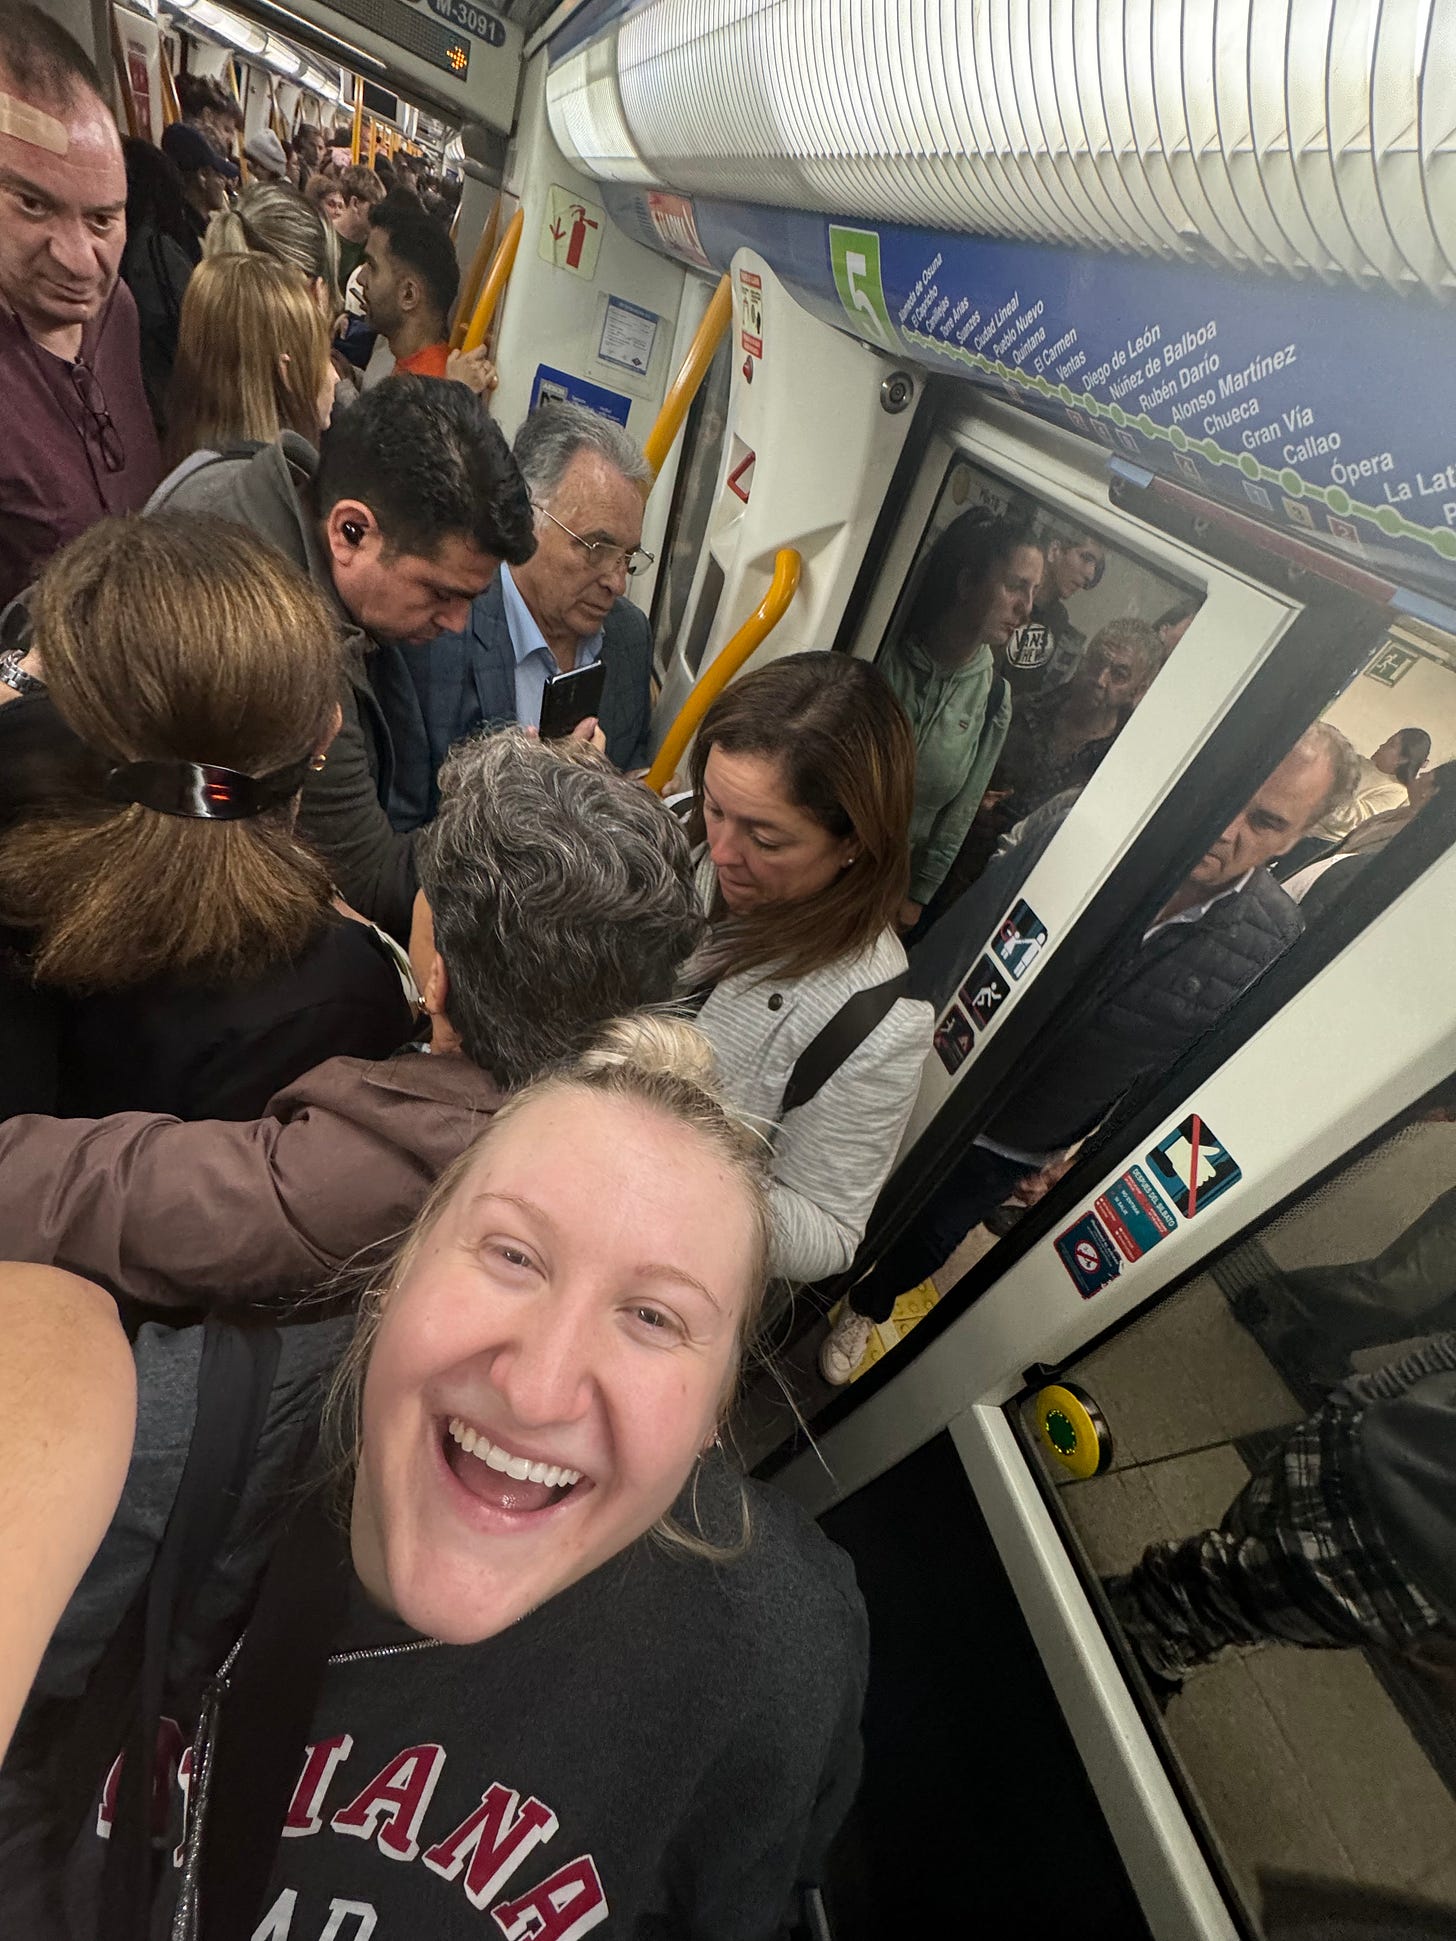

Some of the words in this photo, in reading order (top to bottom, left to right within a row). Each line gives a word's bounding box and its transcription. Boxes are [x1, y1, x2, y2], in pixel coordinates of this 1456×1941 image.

[436, 0, 496, 41] M-3091
[922, 252, 943, 285] Osuna
[974, 319, 997, 350] Ciudad
[994, 290, 1019, 328] Lineal
[993, 328, 1017, 357] Pueblo
[1015, 300, 1044, 335] Nuevo
[1012, 326, 1046, 365] Quintana
[1034, 355, 1045, 373] El
[1042, 328, 1078, 366] Carmen
[1056, 351, 1087, 381] Ventas
[1082, 363, 1111, 391] Diego
[1111, 349, 1127, 370] de
[1127, 323, 1161, 359] León
[1109, 368, 1145, 401] Núñez
[1145, 357, 1162, 378] de
[1163, 320, 1217, 367] Balboa
[1138, 379, 1178, 413] Rubén
[1178, 352, 1220, 390] Darío
[1170, 389, 1216, 424] Alonso
[1217, 344, 1297, 400] Martínez
[1203, 397, 1260, 436] Chueca
[1241, 422, 1282, 450] Gran
[1282, 405, 1314, 433] Vía
[1282, 432, 1341, 465] Callao
[1330, 451, 1395, 487] Ópera
[1383, 482, 1412, 503] La
[1415, 464, 1456, 496] Lat
